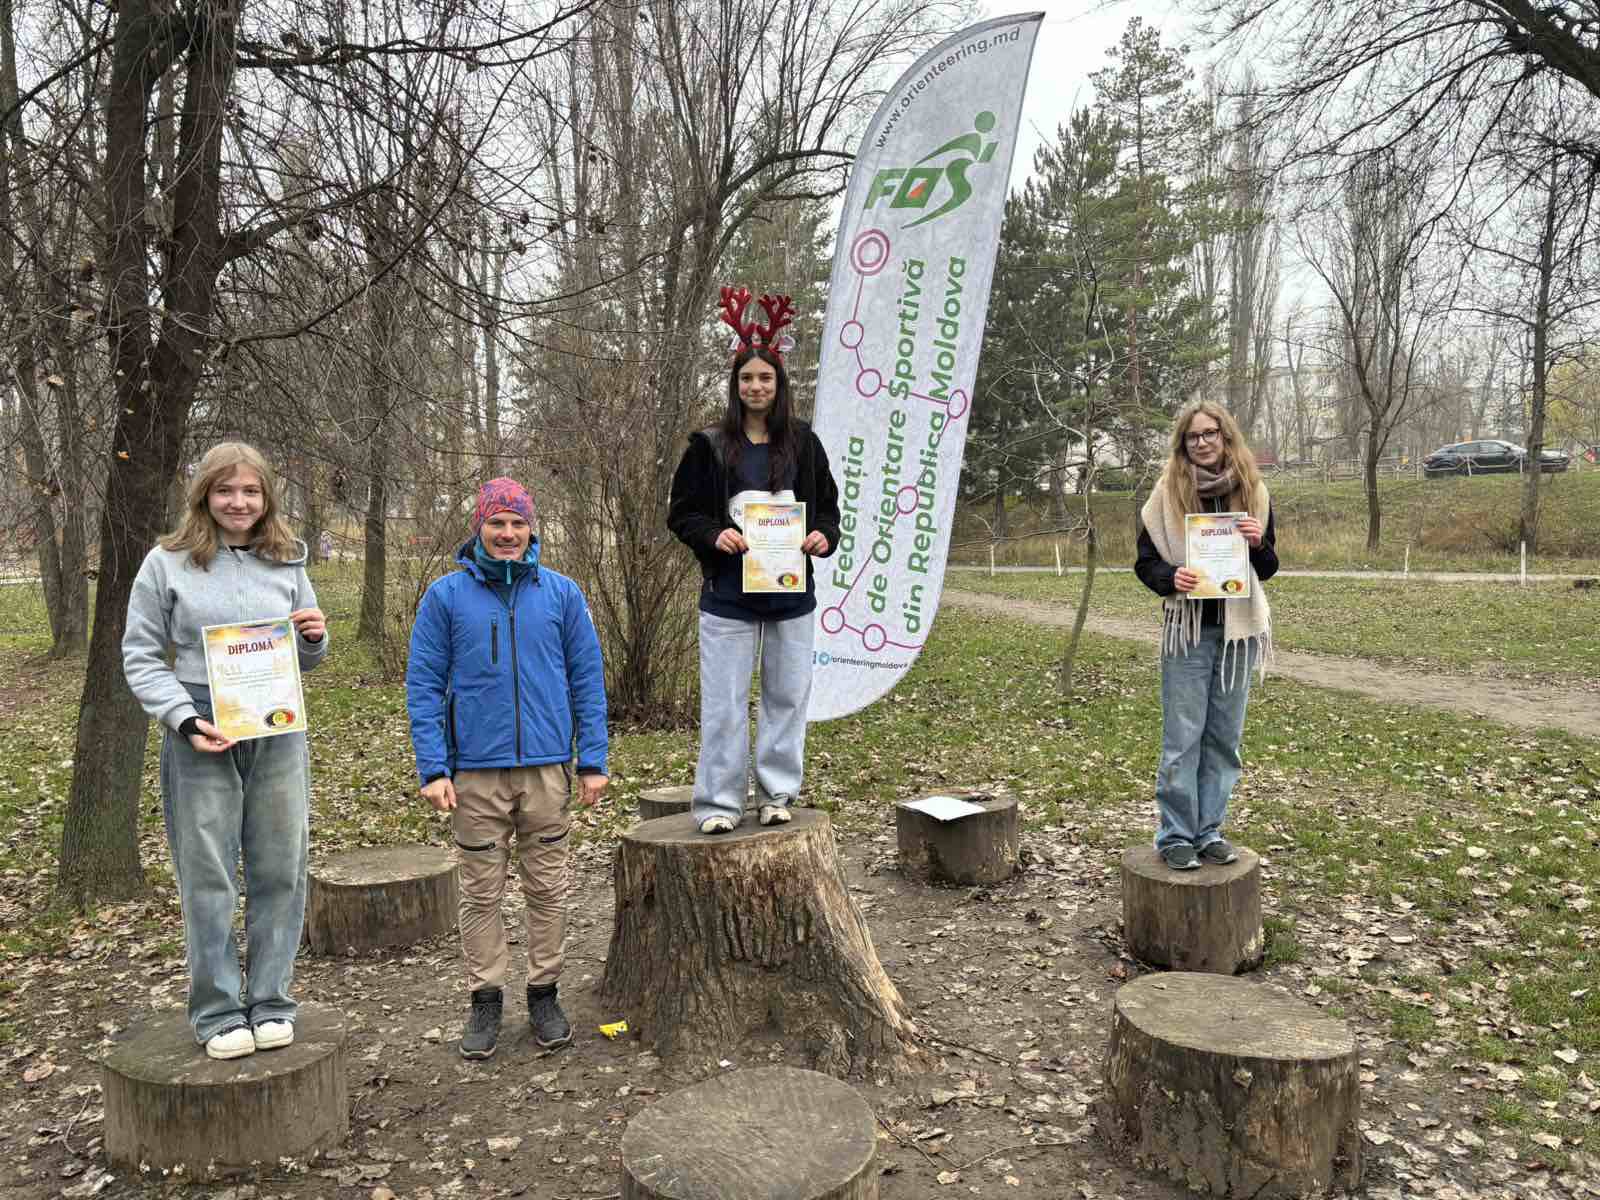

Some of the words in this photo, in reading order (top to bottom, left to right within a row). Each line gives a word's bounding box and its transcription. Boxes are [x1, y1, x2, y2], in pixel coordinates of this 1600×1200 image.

[875, 27, 1021, 149] www.orienteering.md
[888, 258, 926, 400] Sportivă
[928, 256, 966, 400] Moldova
[872, 410, 906, 564] Orientare
[908, 411, 945, 574] Republica
[867, 573, 888, 613] de
[904, 584, 924, 634] din
